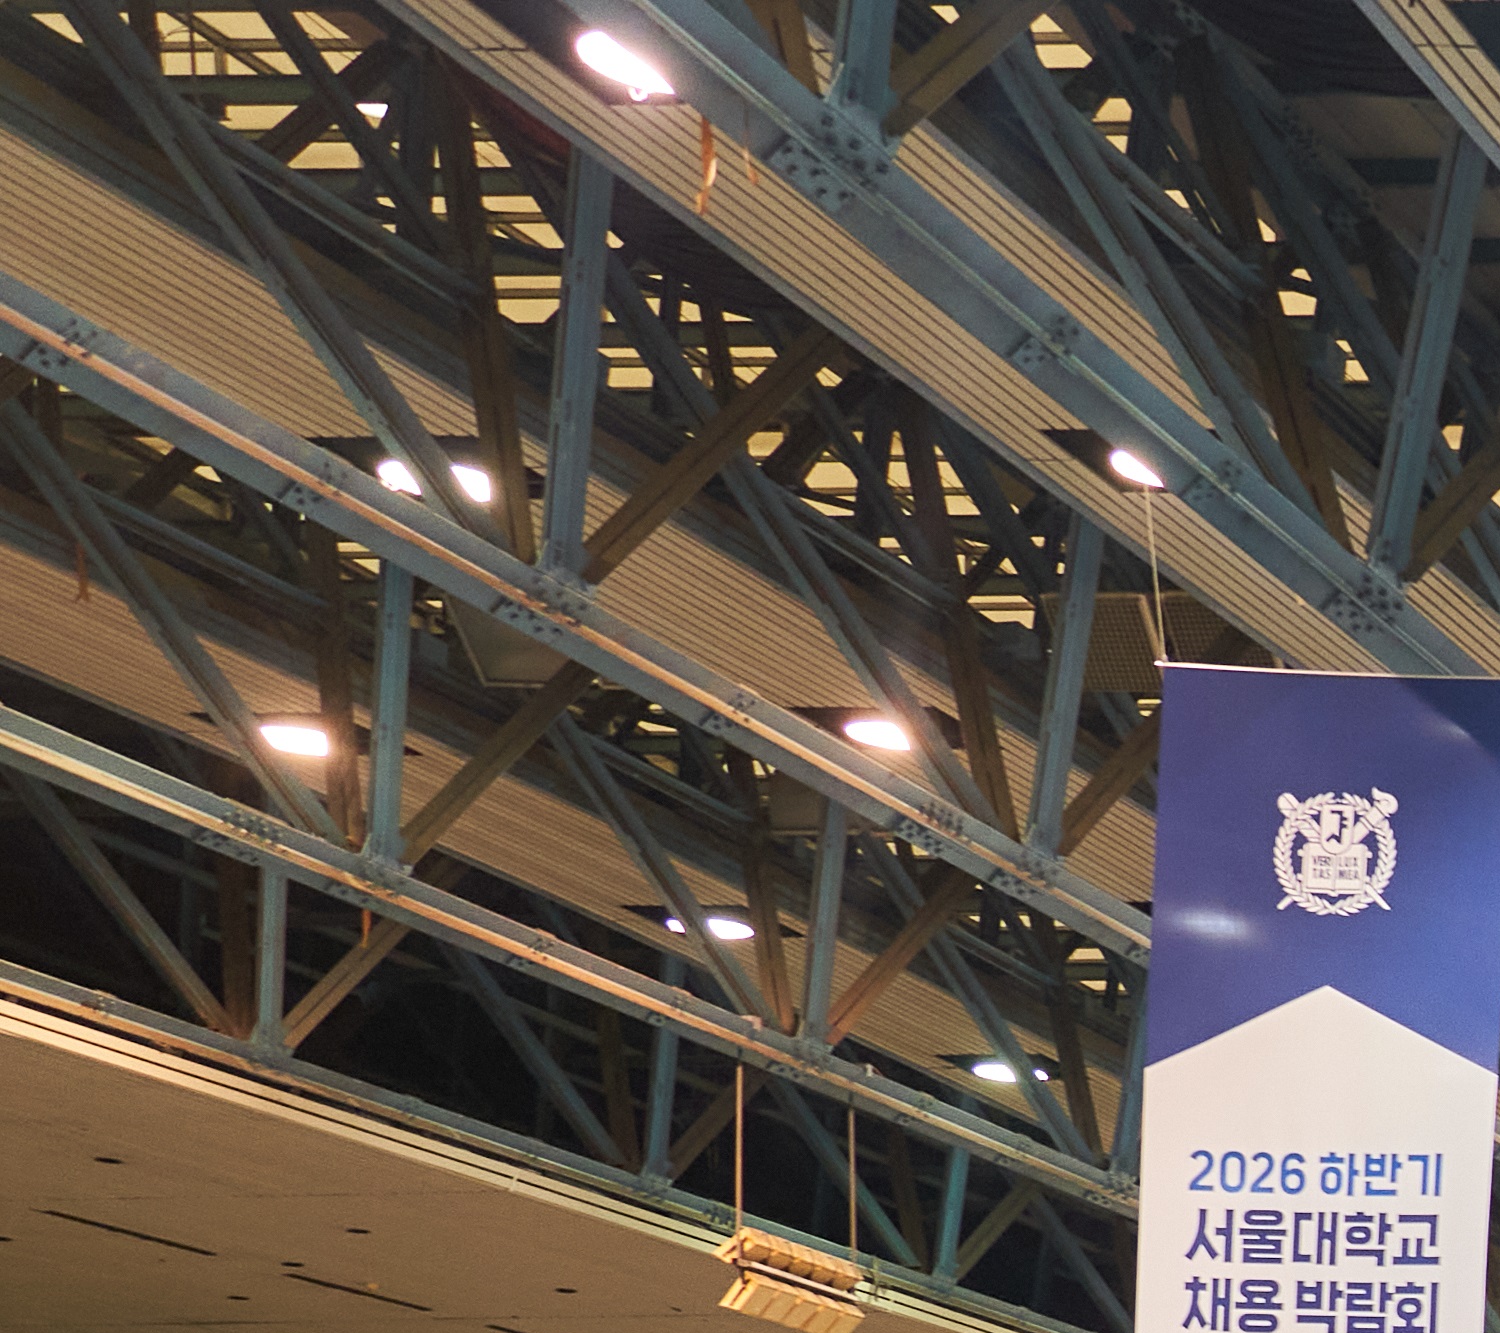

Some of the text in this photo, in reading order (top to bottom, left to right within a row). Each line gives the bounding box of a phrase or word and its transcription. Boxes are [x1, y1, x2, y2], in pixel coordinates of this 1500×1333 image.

[1189, 1150, 1442, 1196] 2026 하반기
[1184, 1208, 1443, 1266] 서울대학교
[1182, 1276, 1283, 1333] 채용
